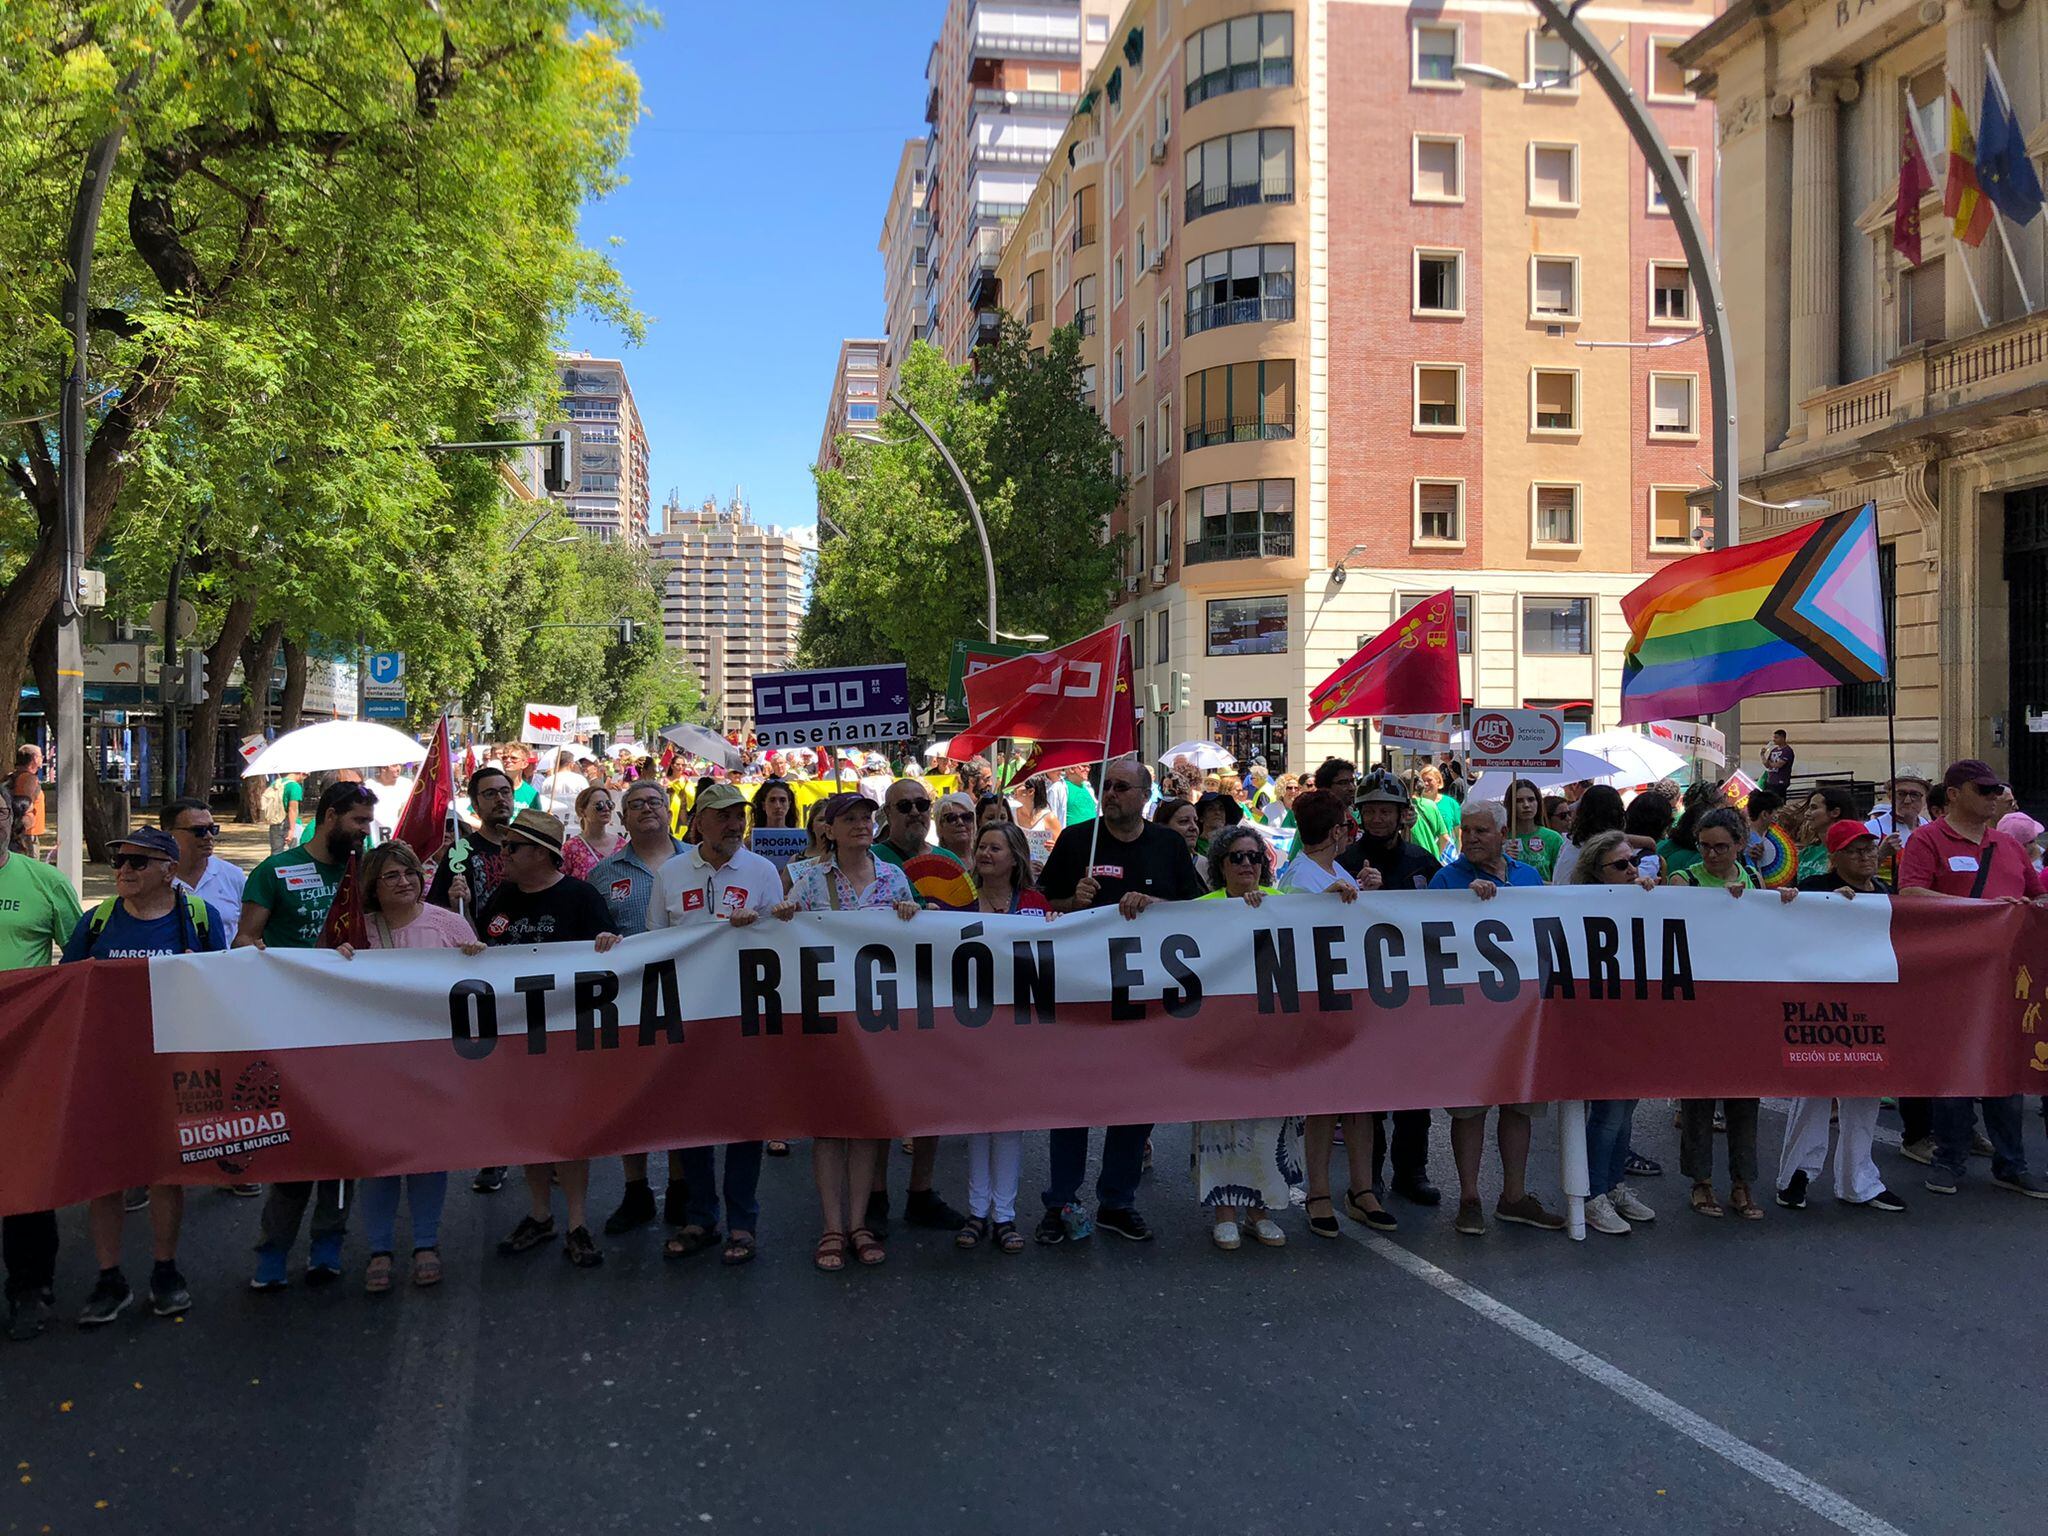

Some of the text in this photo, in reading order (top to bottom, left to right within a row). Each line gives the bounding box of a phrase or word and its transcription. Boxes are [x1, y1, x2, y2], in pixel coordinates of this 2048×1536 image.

[377, 657, 391, 676] P
[756, 680, 865, 715] CCOO
[1216, 700, 1273, 713] PRIMOR
[756, 720, 909, 747] enseñanza
[1394, 726, 1414, 738] Región
[1414, 729, 1422, 738] de
[1477, 720, 1509, 737] UGT
[1486, 759, 1510, 767] Región
[1016, 907, 1044, 916] COO
[108, 949, 173, 958] MARCHAS
[448, 916, 1697, 1060] OTRA REGIÓN ES NECESARIA
[1782, 1001, 1848, 1022] PLAN
[1784, 1025, 1886, 1048] CHOQUE
[1789, 1050, 1883, 1062] REGIÓN DE MURCIA
[172, 1068, 221, 1089] PAN
[176, 1100, 224, 1114] TECHO
[180, 1111, 287, 1146] DIGNIDAD
[182, 1132, 290, 1163] REGIÓN DE MURCIA
